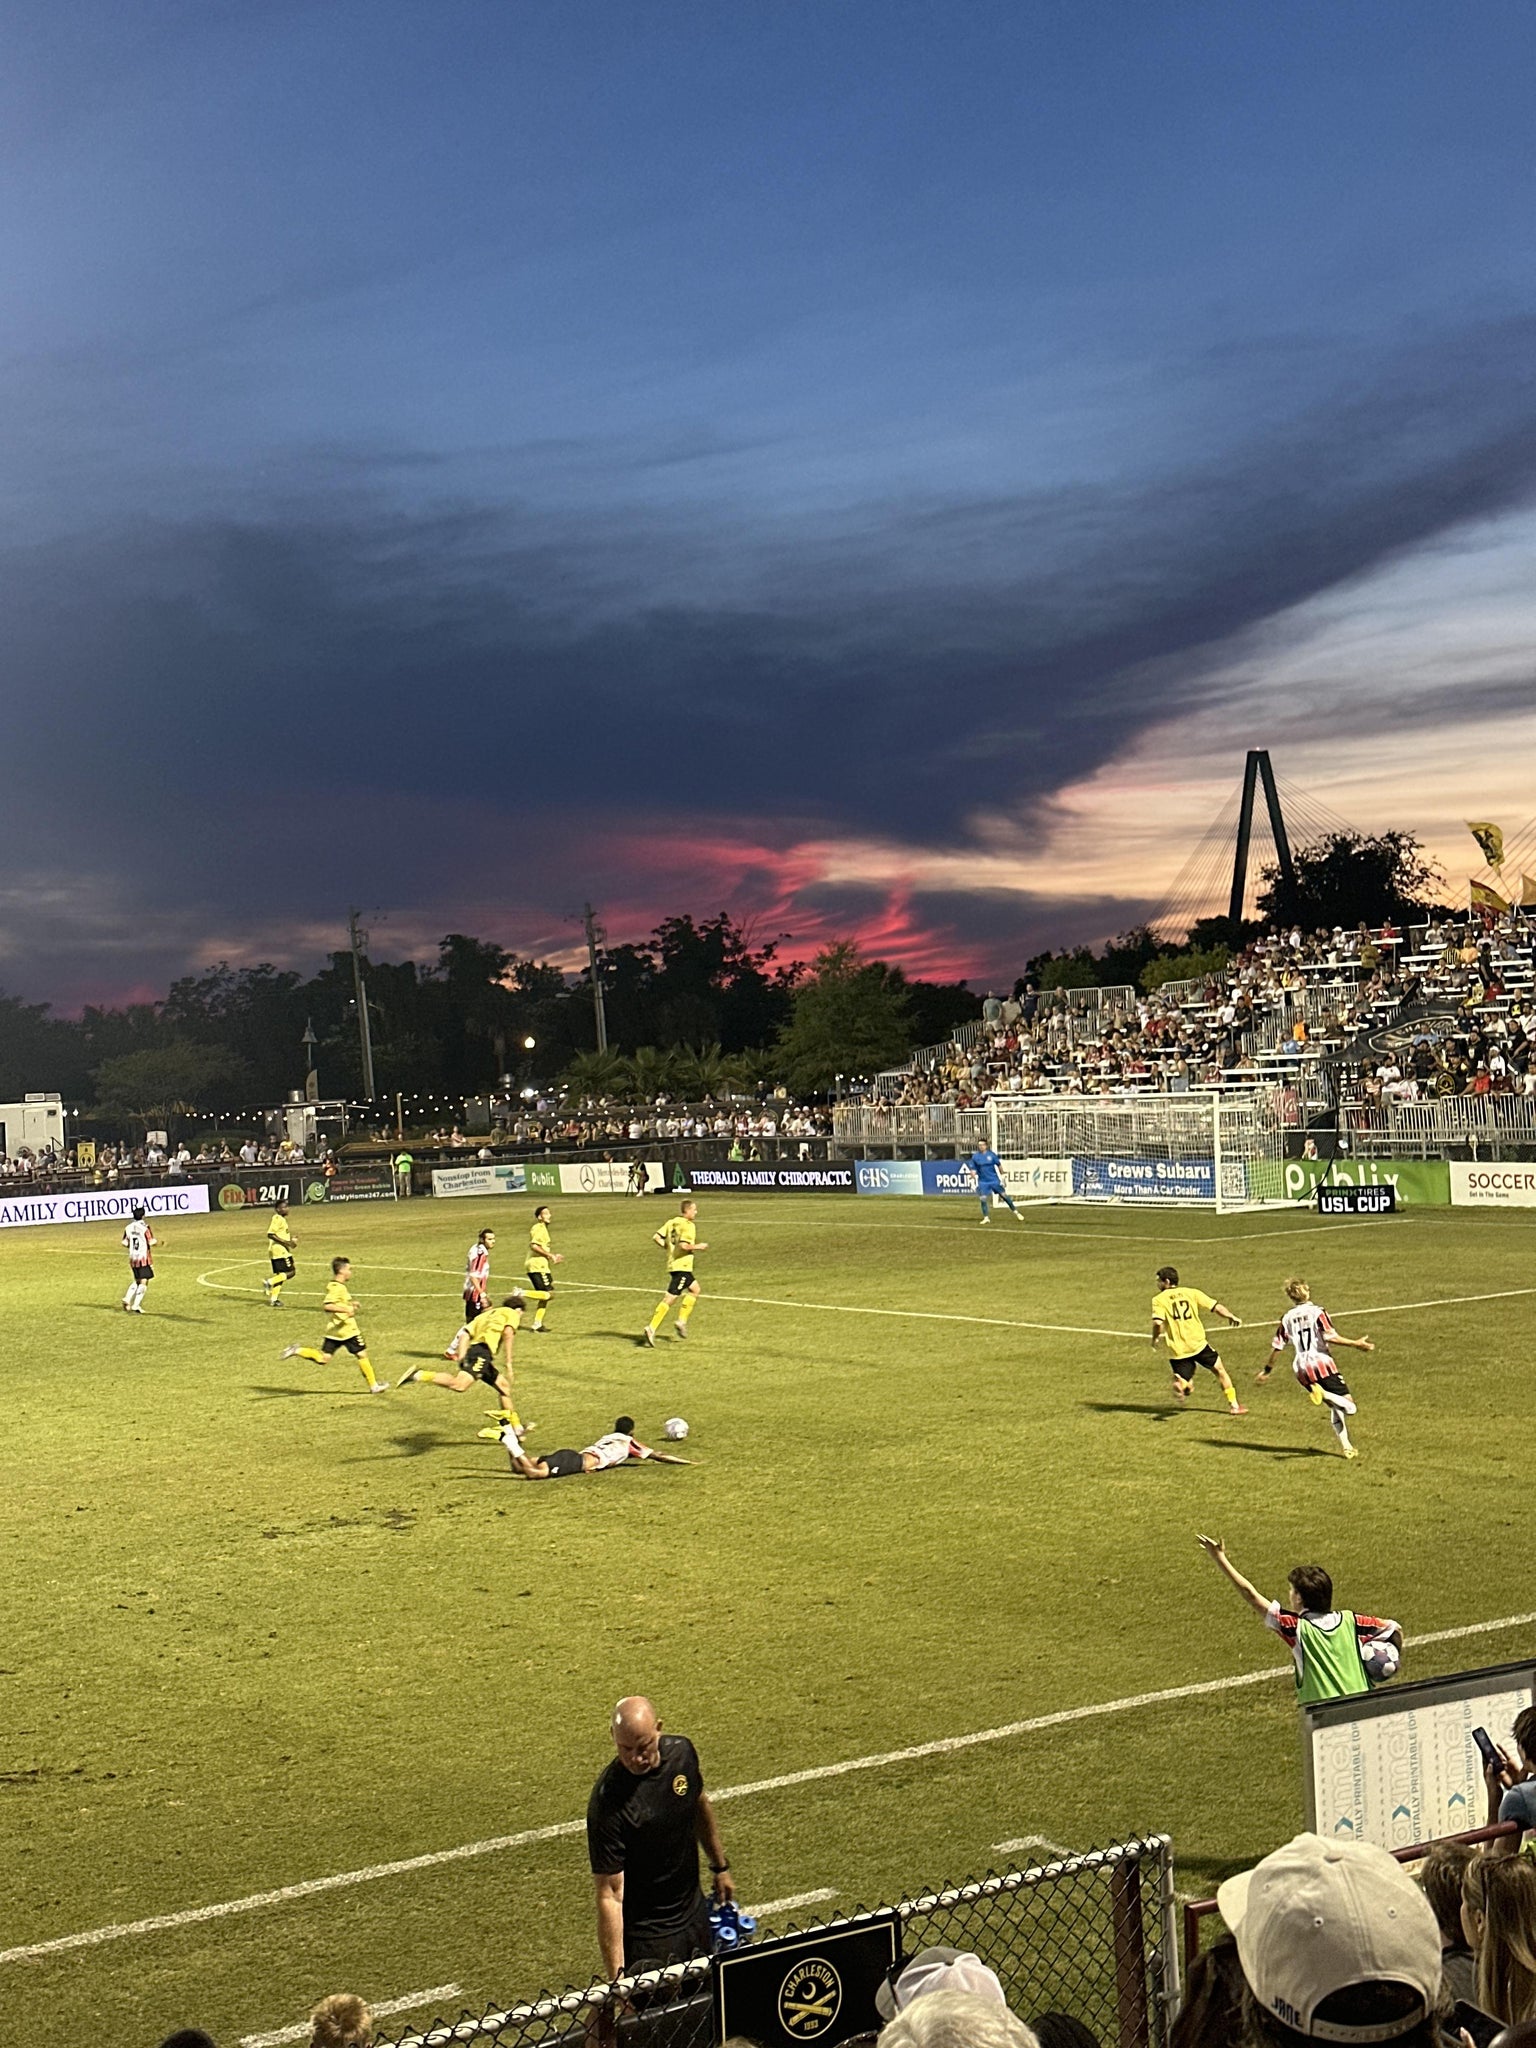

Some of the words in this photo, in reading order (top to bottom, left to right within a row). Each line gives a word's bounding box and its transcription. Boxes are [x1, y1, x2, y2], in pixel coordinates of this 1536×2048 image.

[531, 1172, 556, 1186] Publix
[690, 1171, 740, 1185] THEOBALD
[741, 1171, 777, 1185] FAMILY
[778, 1170, 852, 1186] CHIROPRACTIC
[859, 1167, 890, 1188] CHS
[1043, 1171, 1068, 1182] FEET
[1108, 1162, 1153, 1178] Crews
[1156, 1162, 1210, 1179] Subaru
[443, 1178, 488, 1190] Charleston
[1114, 1184, 1133, 1194] More
[1134, 1184, 1152, 1194] Than
[1153, 1184, 1159, 1194] A
[1160, 1185, 1173, 1194] Car
[1468, 1173, 1536, 1190] SOCCER
[259, 1184, 289, 1201] 24/7
[1358, 1187, 1385, 1195] TIRES
[64, 1193, 190, 1218] CHIROPRACTIC
[1321, 1197, 1354, 1212] USL
[1357, 1196, 1390, 1212] CUP
[1172, 1300, 1192, 1320] 42
[1297, 1327, 1311, 1351] 17
[1463, 1721, 1475, 1782] PRINTABLE
[1408, 1732, 1419, 1794] PRINTABLE
[1351, 1745, 1362, 1806] PRINTABLE
[784, 1964, 835, 1998] CHARLESTON
